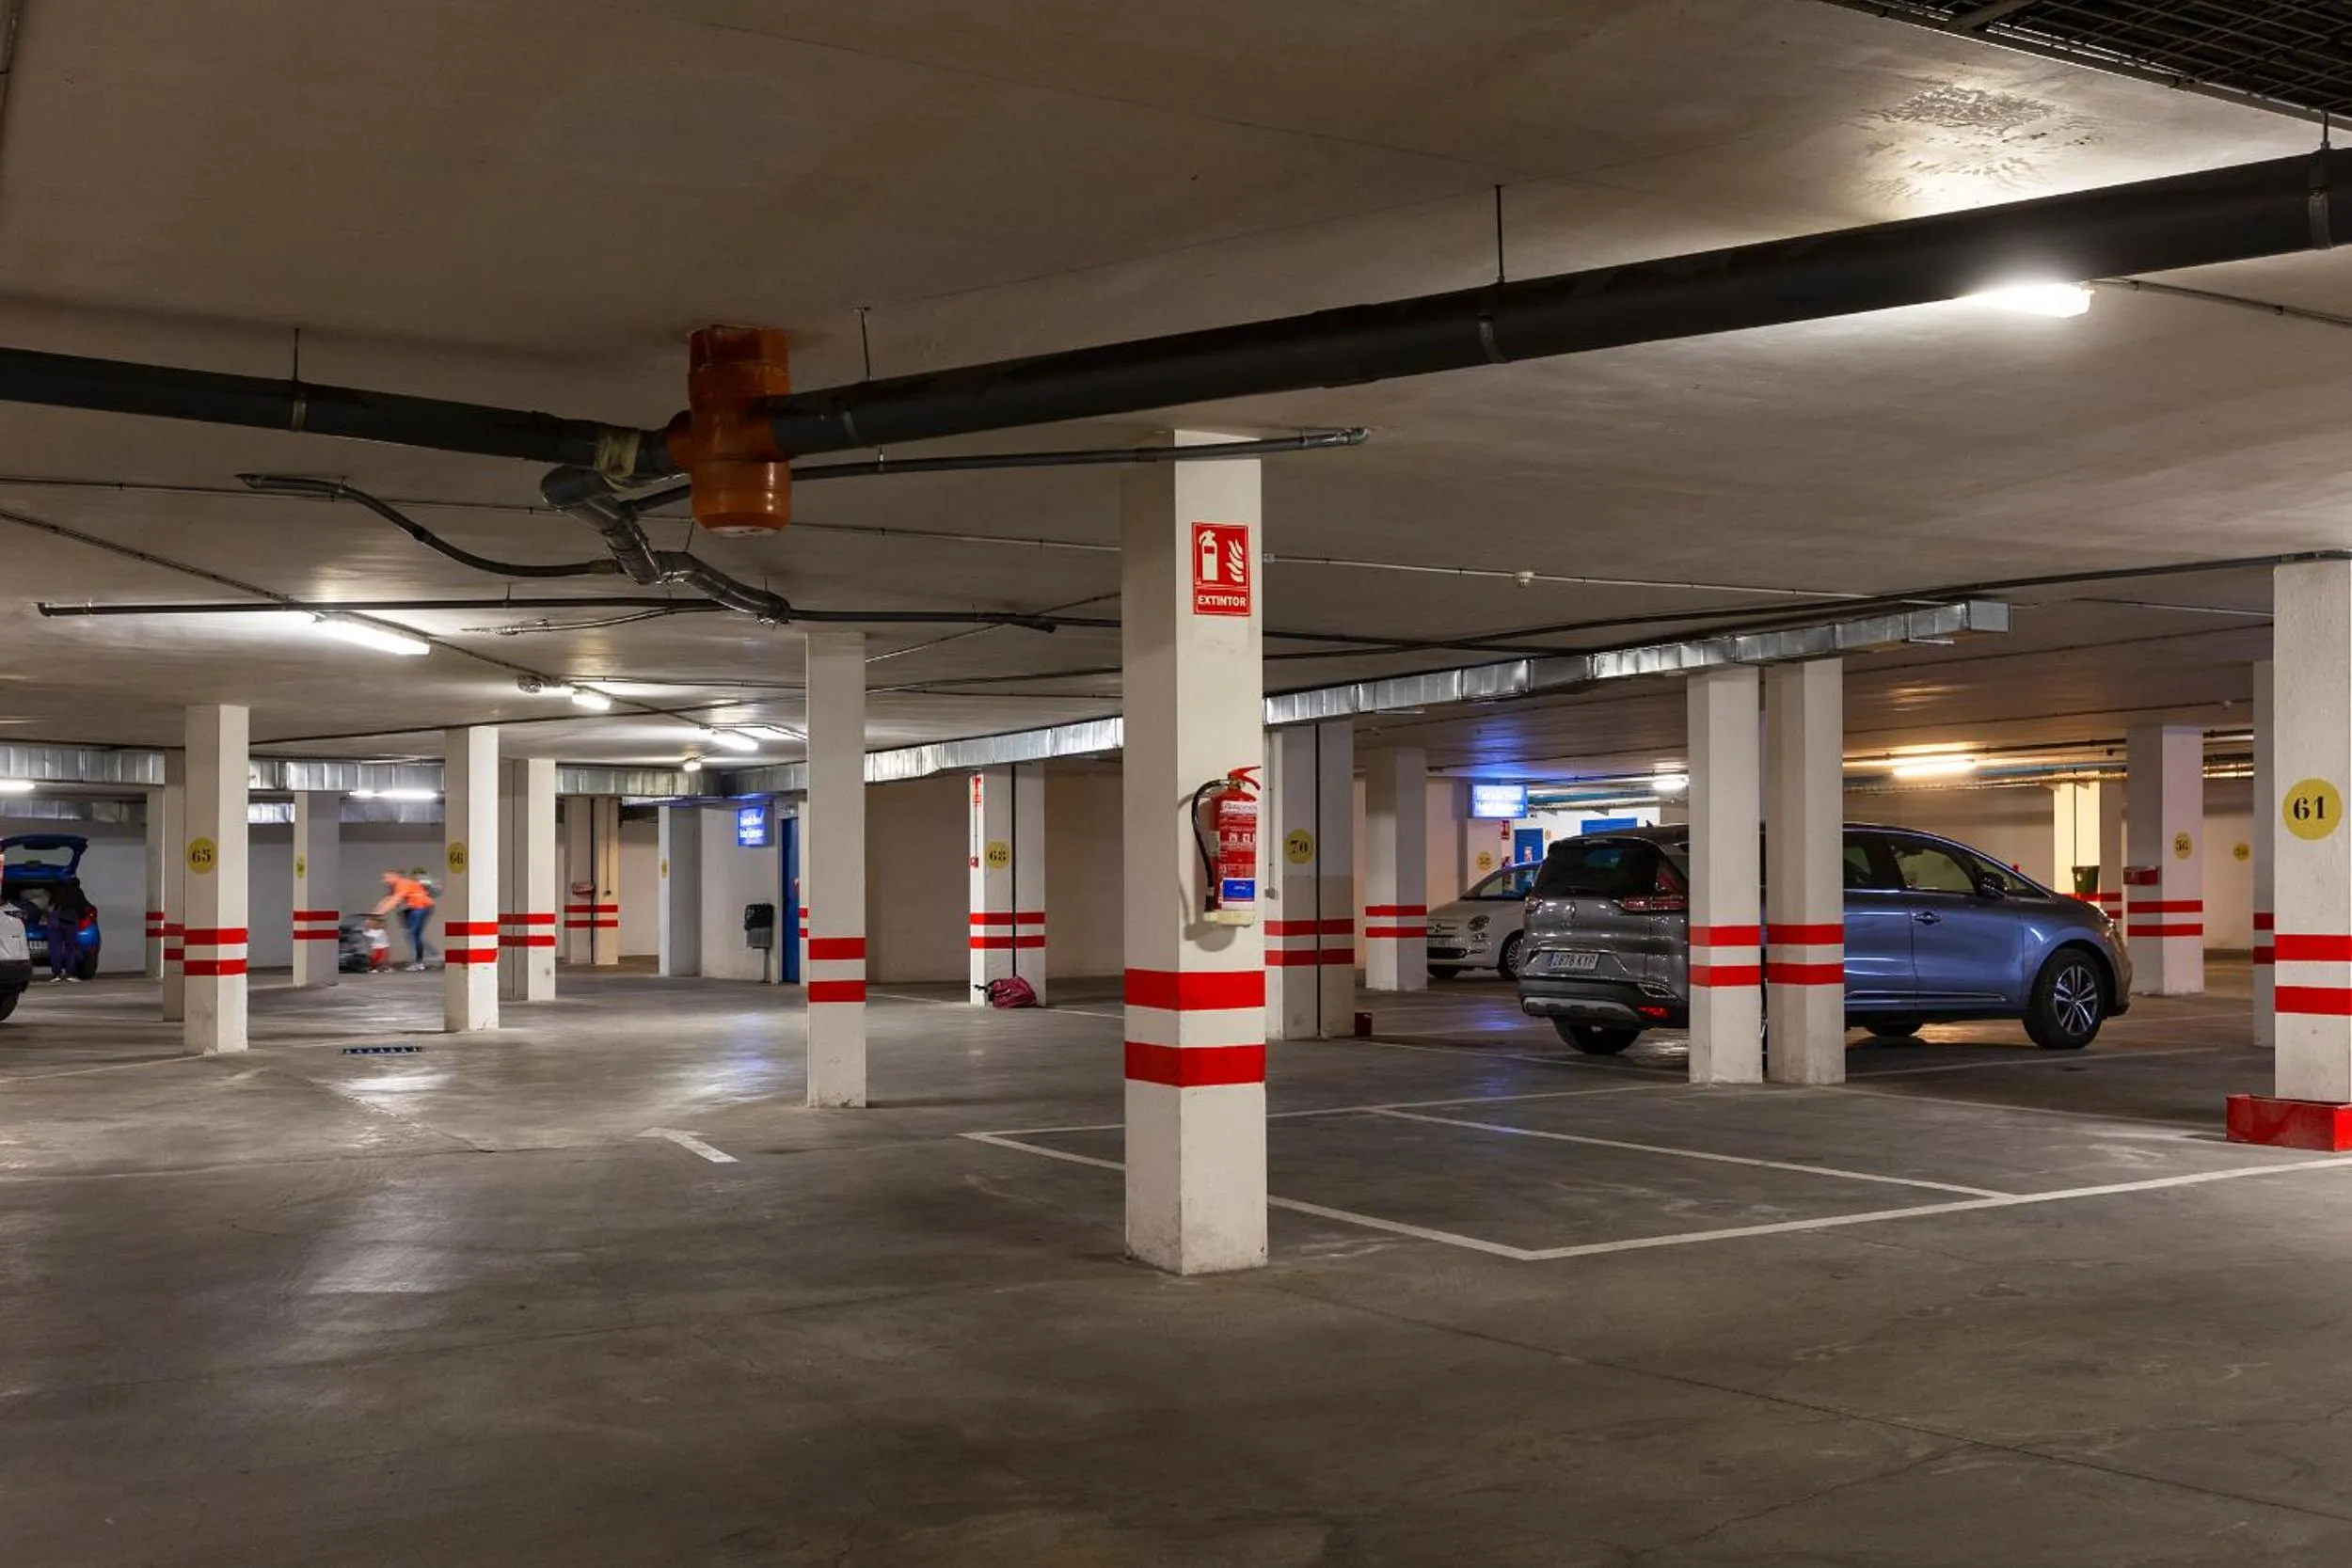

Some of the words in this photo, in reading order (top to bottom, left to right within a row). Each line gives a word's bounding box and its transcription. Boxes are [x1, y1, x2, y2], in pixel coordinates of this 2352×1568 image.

[1198, 594, 1247, 607] EXTINTOR
[2293, 796, 2325, 820] 61
[1290, 839, 1308, 853] 70
[192, 848, 212, 863] 65
[450, 851, 464, 865] 66
